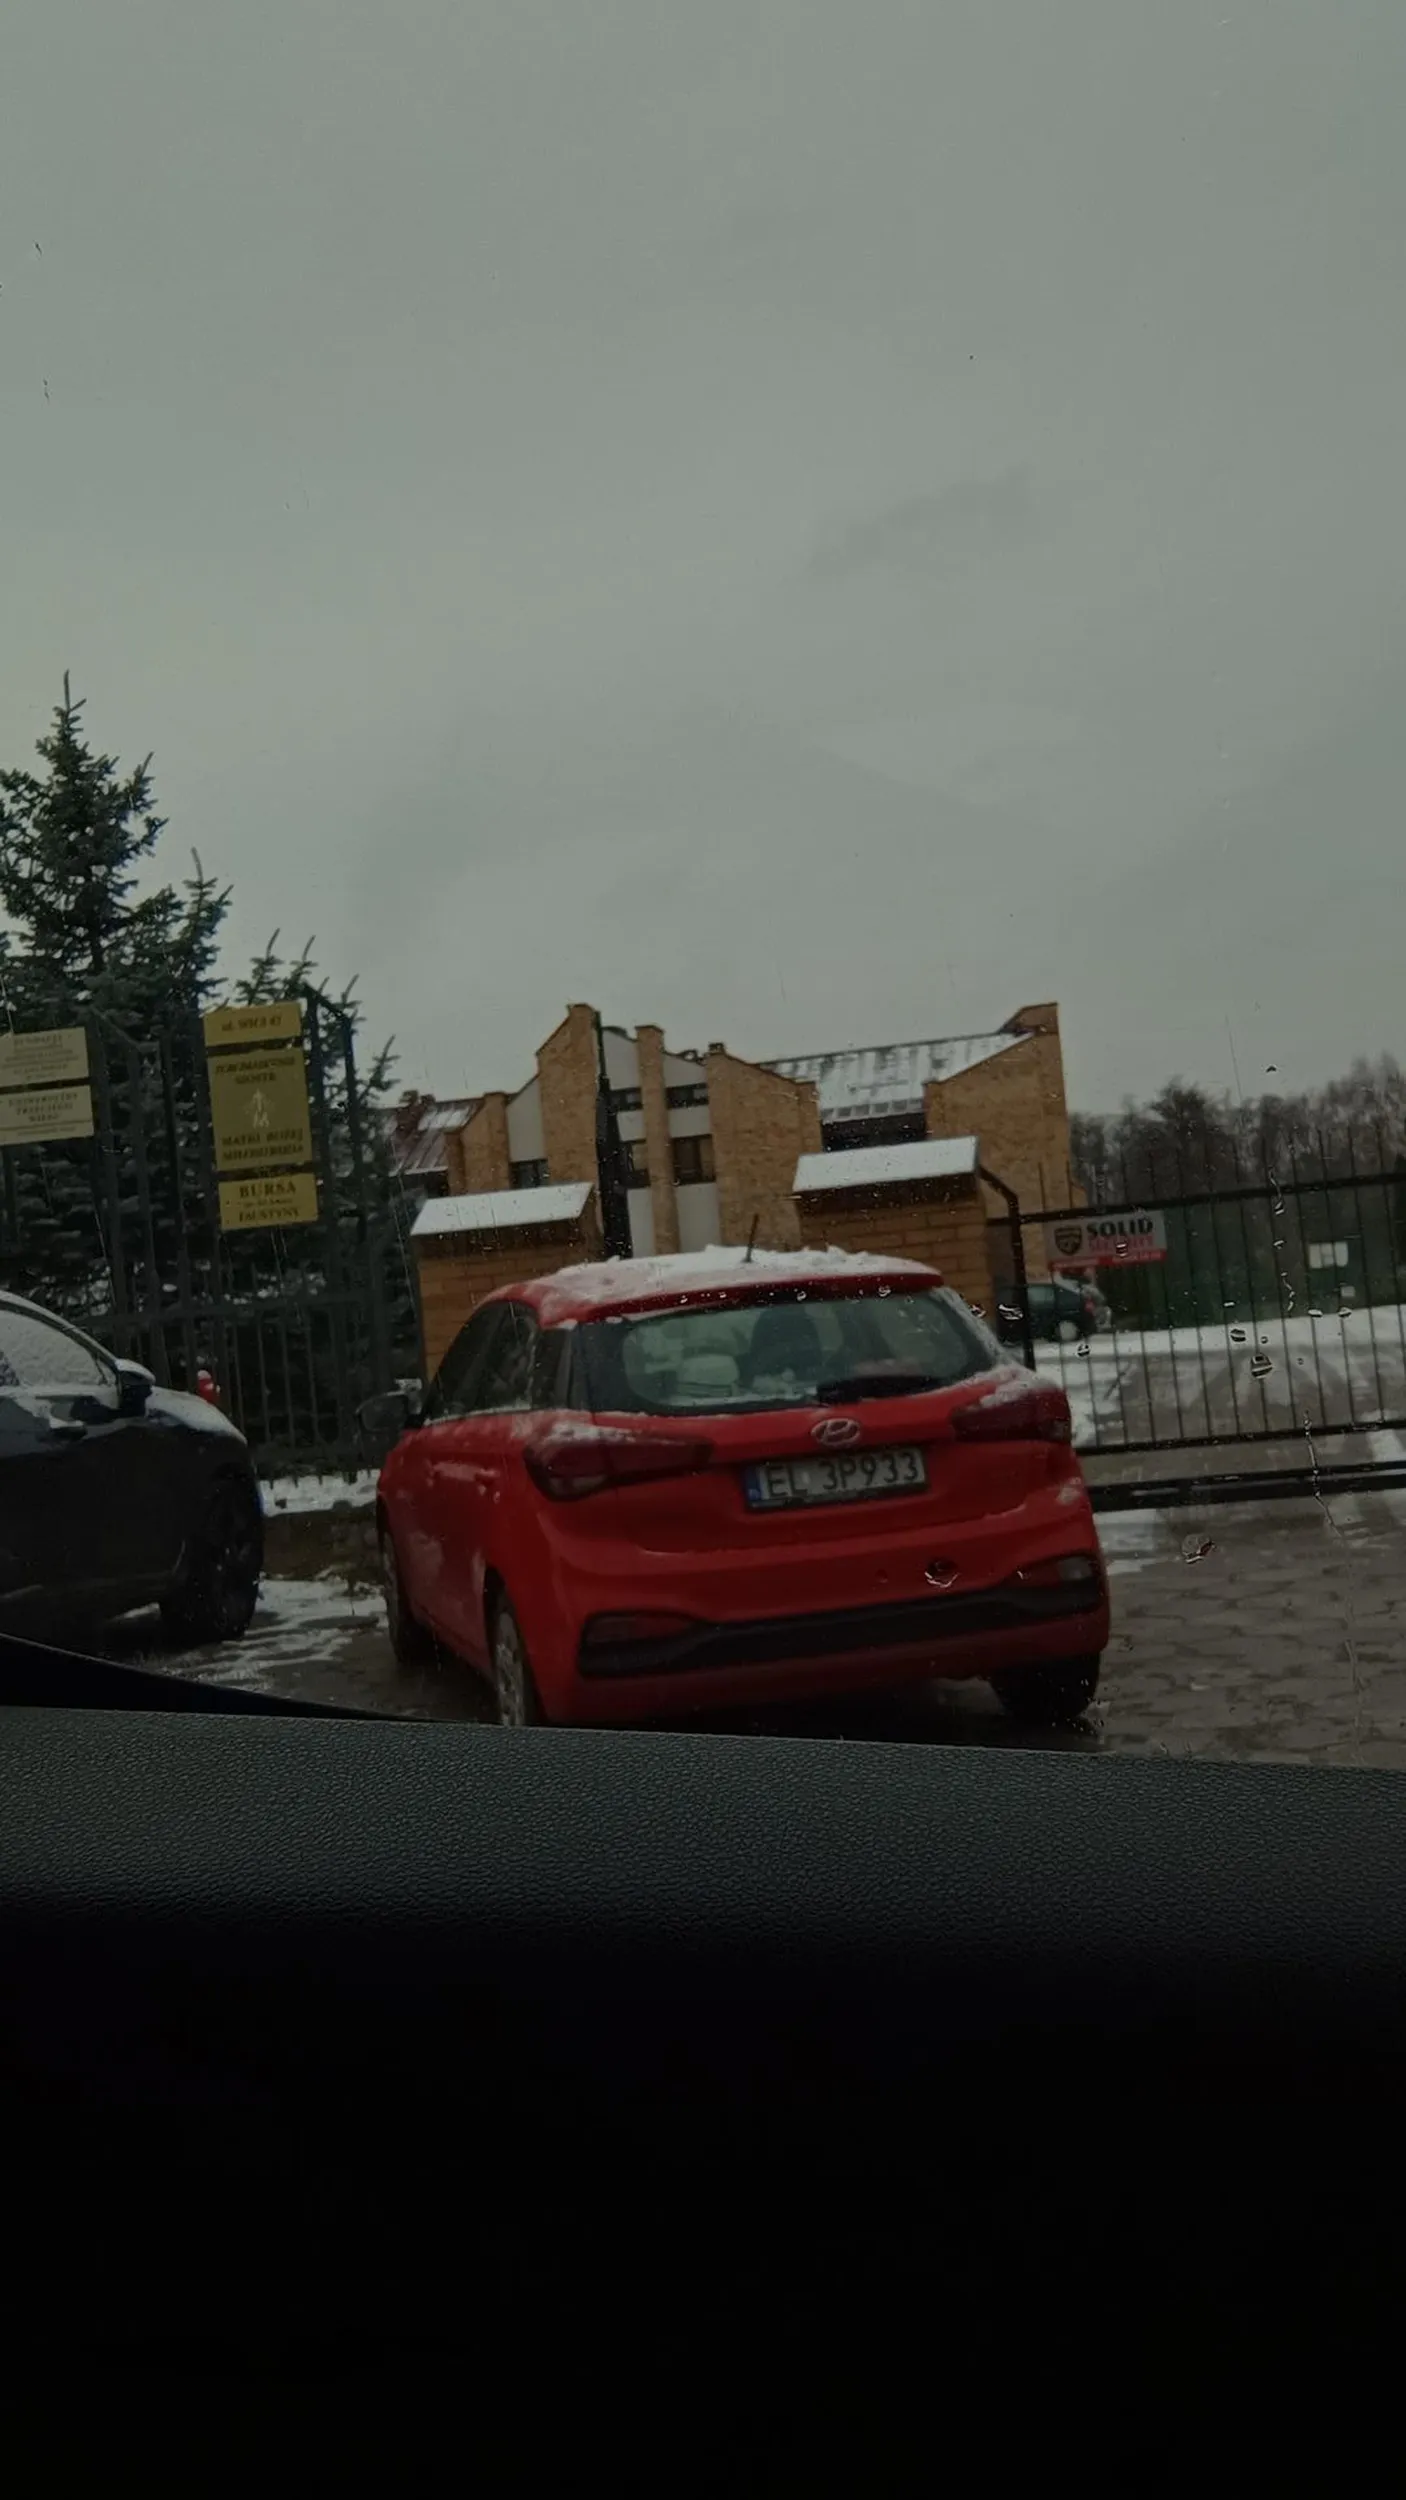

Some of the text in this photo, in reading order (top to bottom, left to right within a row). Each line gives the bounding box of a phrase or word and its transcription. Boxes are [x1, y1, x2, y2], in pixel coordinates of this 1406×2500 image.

[240, 1180, 296, 1198] BURSA
[239, 1208, 300, 1222] FAUSTYNY
[1087, 1218, 1153, 1237] SOLID
[767, 1452, 918, 1497] EL 3P933
